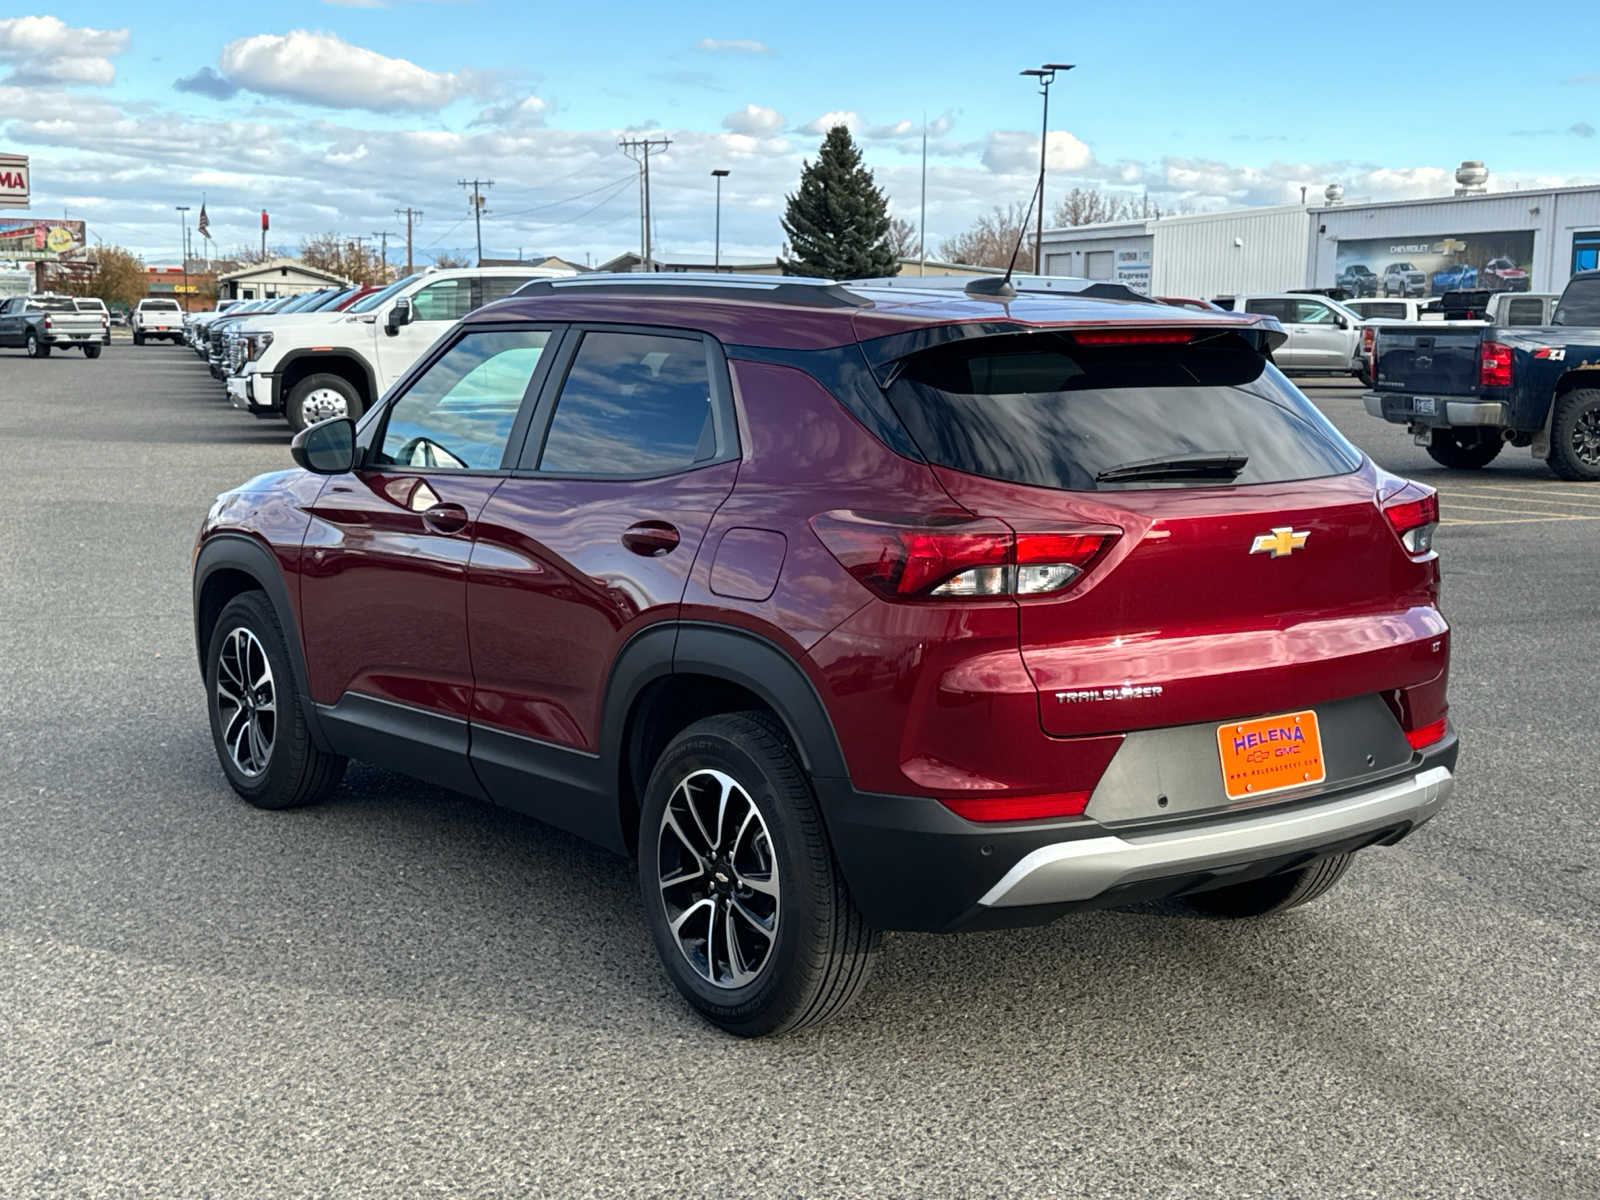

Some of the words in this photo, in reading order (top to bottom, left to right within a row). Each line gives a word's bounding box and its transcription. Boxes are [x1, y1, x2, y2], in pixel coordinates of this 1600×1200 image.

[1118, 271, 1149, 280] Express
[1055, 685, 1162, 704] TRAILBLAZER
[1233, 726, 1305, 755] HELENA
[1274, 745, 1301, 757] GMC
